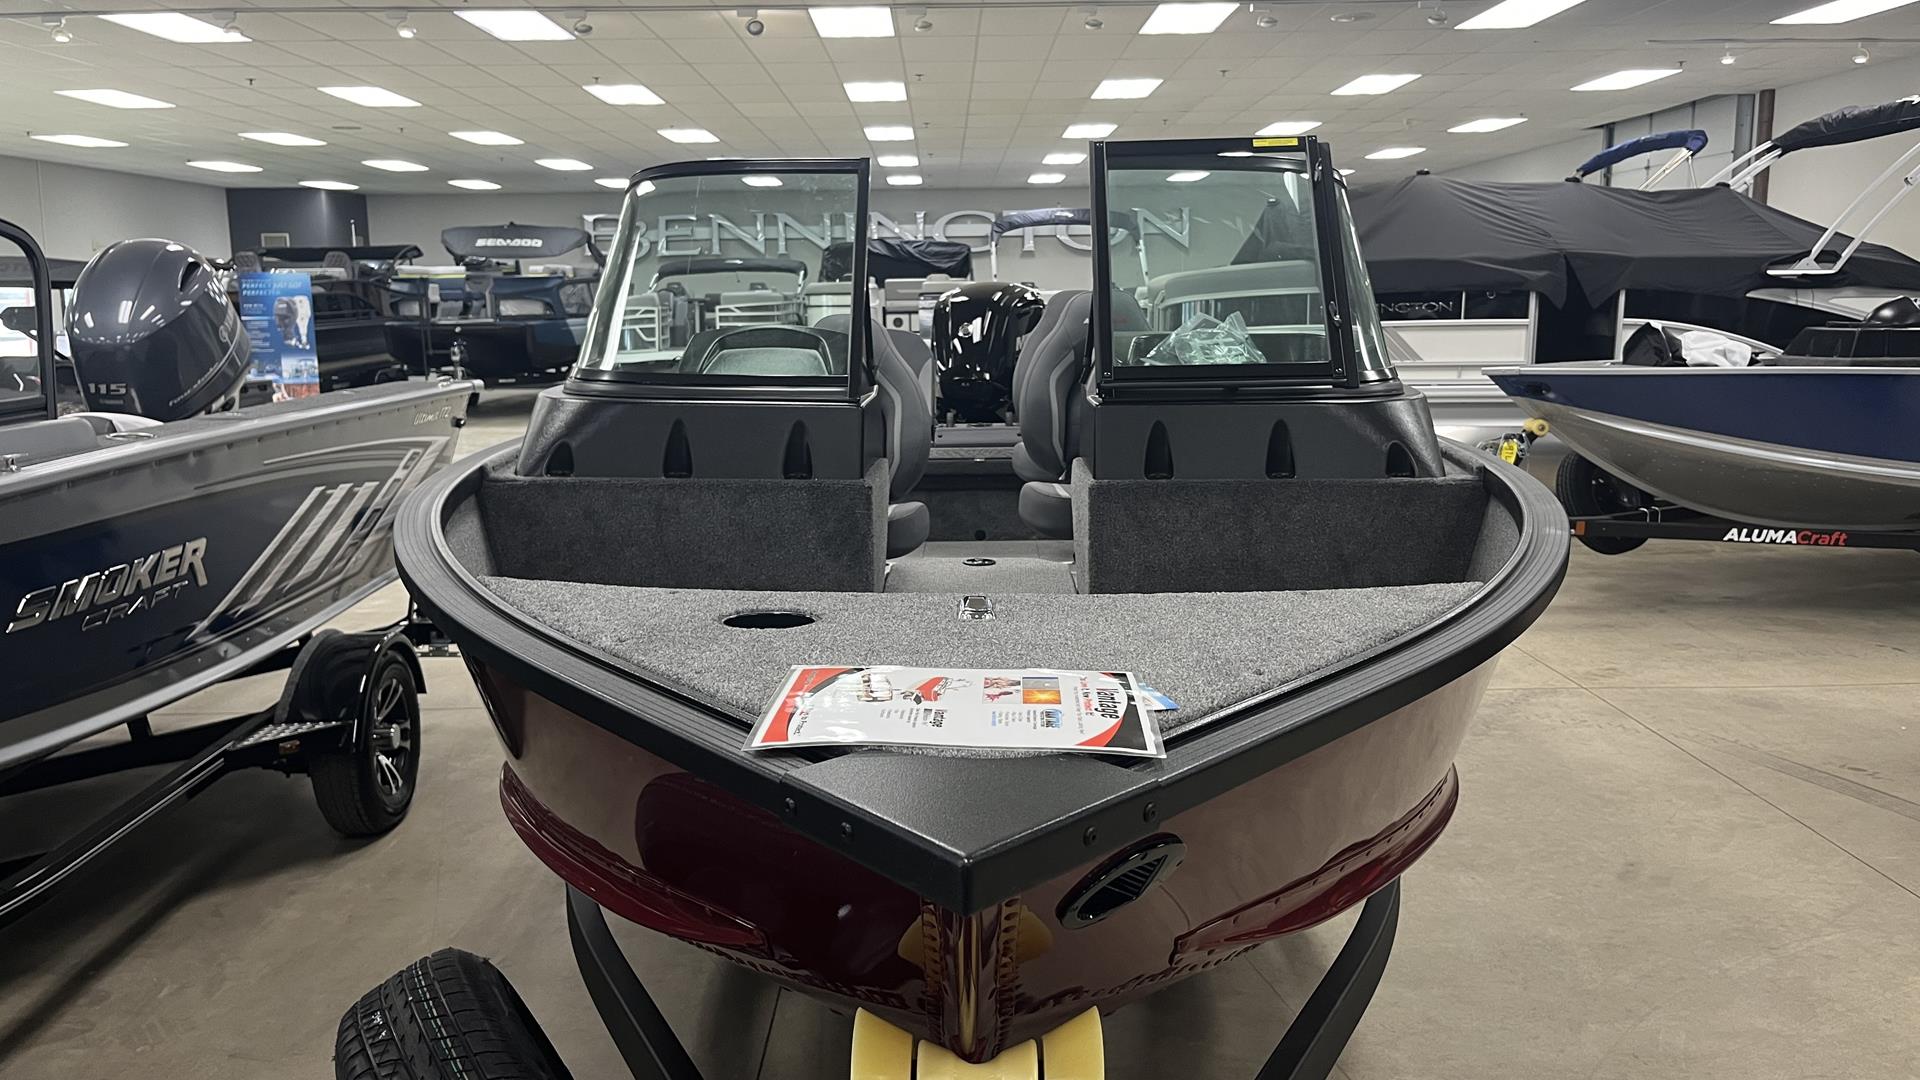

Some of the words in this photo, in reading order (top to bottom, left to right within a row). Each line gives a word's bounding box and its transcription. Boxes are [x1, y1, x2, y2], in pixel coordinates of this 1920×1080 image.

[88, 383, 127, 395] 115
[1723, 528, 1848, 546] ALUMACraft
[6, 537, 208, 634] SMOKER
[81, 580, 189, 632] CRAFT
[1094, 687, 1121, 719] Vantage
